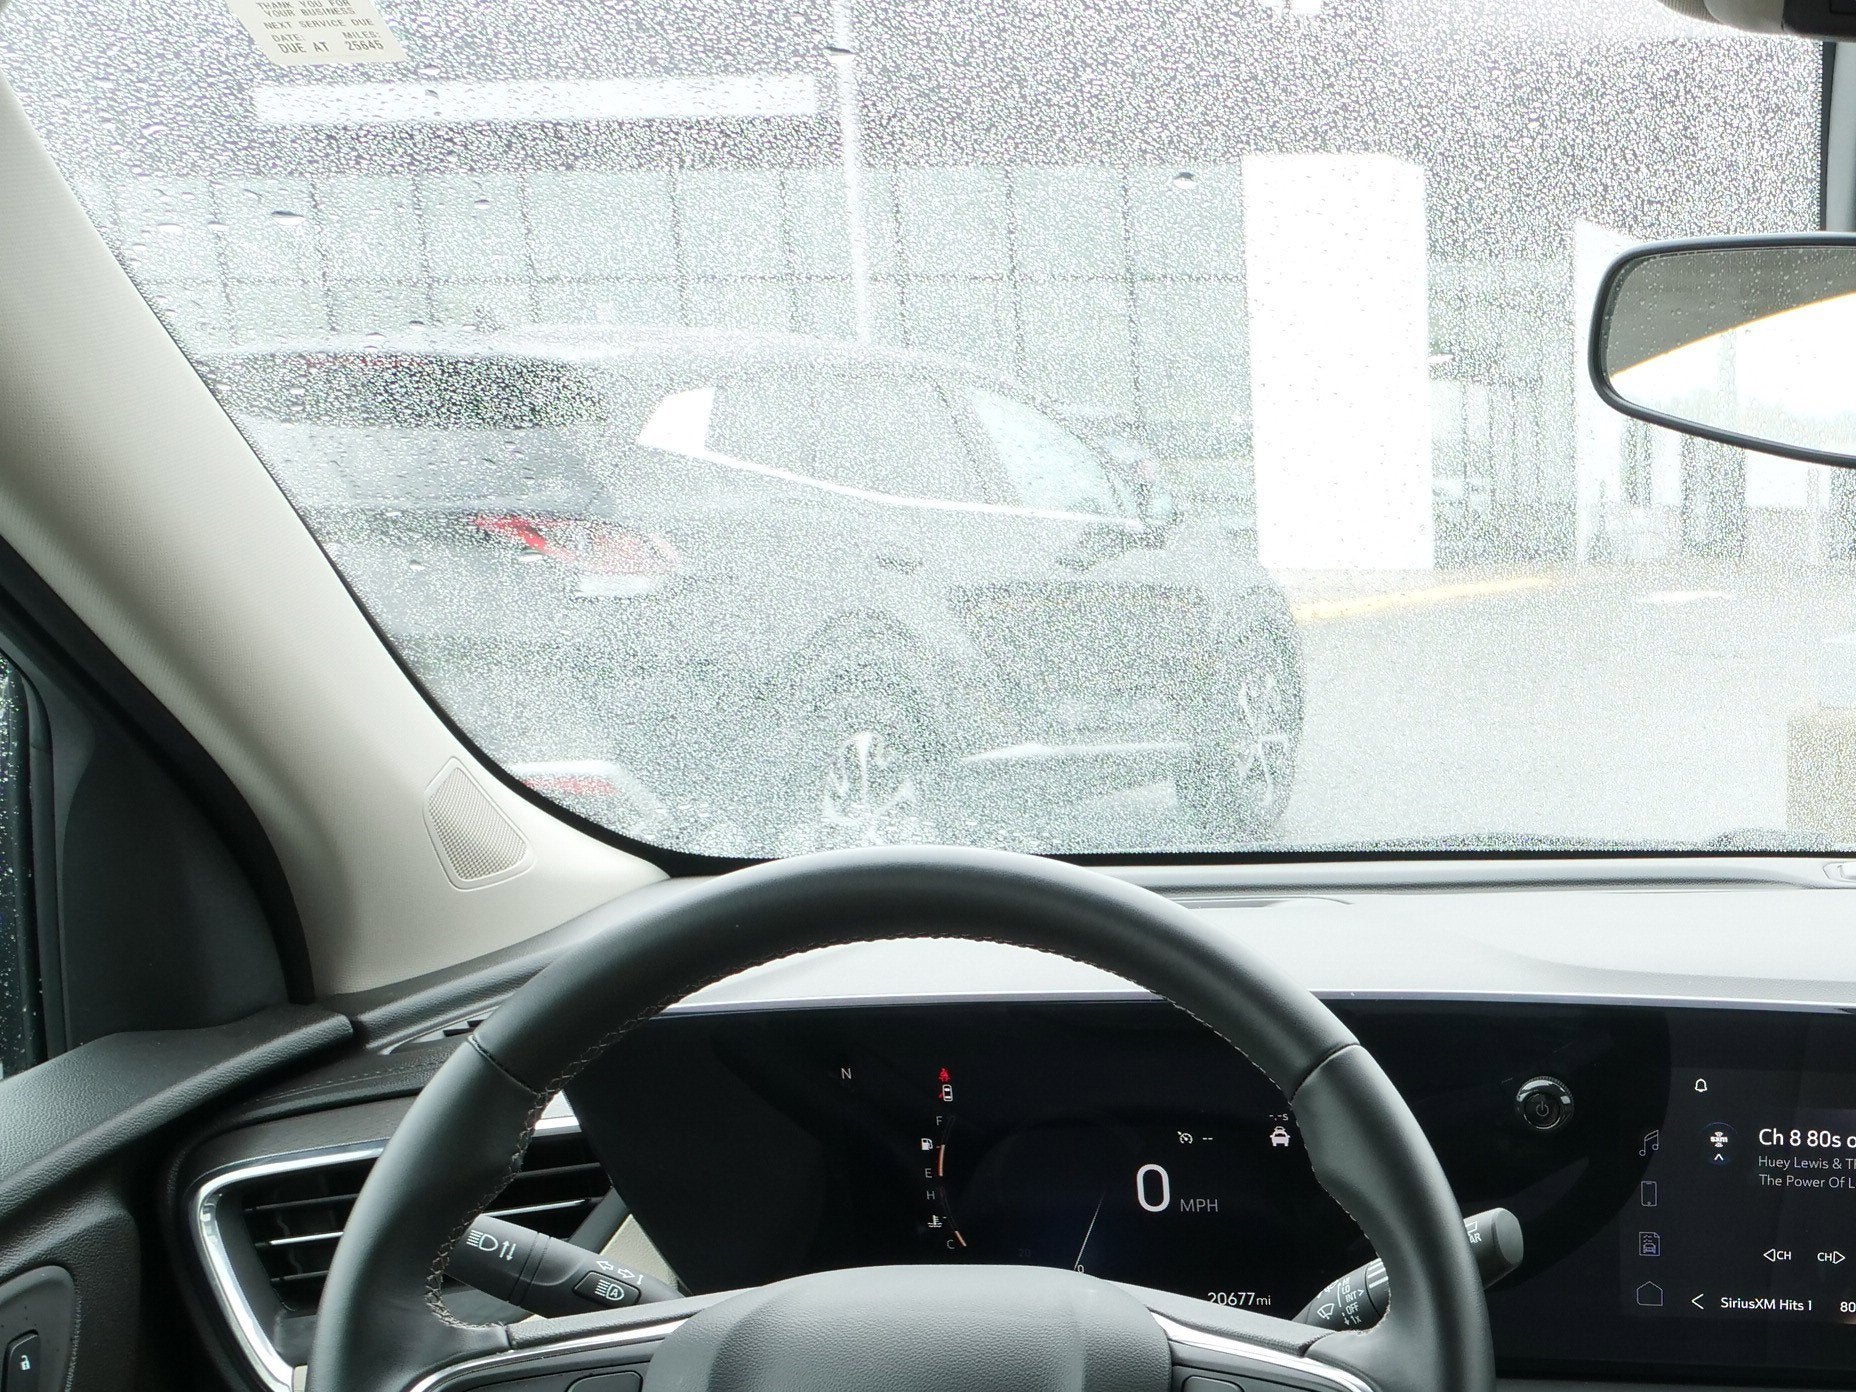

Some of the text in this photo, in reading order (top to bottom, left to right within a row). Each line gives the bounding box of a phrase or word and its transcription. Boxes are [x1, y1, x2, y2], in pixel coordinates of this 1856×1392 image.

[256, 1, 293, 9] THANK
[299, 0, 323, 8] YOU
[264, 7, 356, 17] YOUR BUSINESS
[263, 18, 374, 29] NEXT SERVICE DUE
[272, 31, 381, 42] DATE: MILES:
[278, 40, 384, 53] DUE AT 25645
[841, 1067, 851, 1079] N
[936, 1116, 943, 1125] F
[1759, 1128, 1783, 1145] Ch
[1789, 1129, 1801, 1146] 8
[1807, 1130, 1841, 1148] 80s
[1758, 1155, 1790, 1171] Huey
[1794, 1156, 1829, 1169] Lewis
[1832, 1158, 1842, 1170] &
[925, 1168, 933, 1178] E
[1758, 1173, 1782, 1187] The
[1786, 1175, 1825, 1188] Power
[1829, 1176, 1845, 1188] Of
[1136, 1163, 1170, 1212] 0
[927, 1190, 935, 1200] H
[1180, 1198, 1219, 1213] MPH
[946, 1239, 955, 1250] C
[1777, 1251, 1792, 1260] CH
[1817, 1252, 1832, 1262] CH
[1346, 1302, 1359, 1314] OFF
[1720, 1297, 1813, 1311] SiriusXM Hits 1
